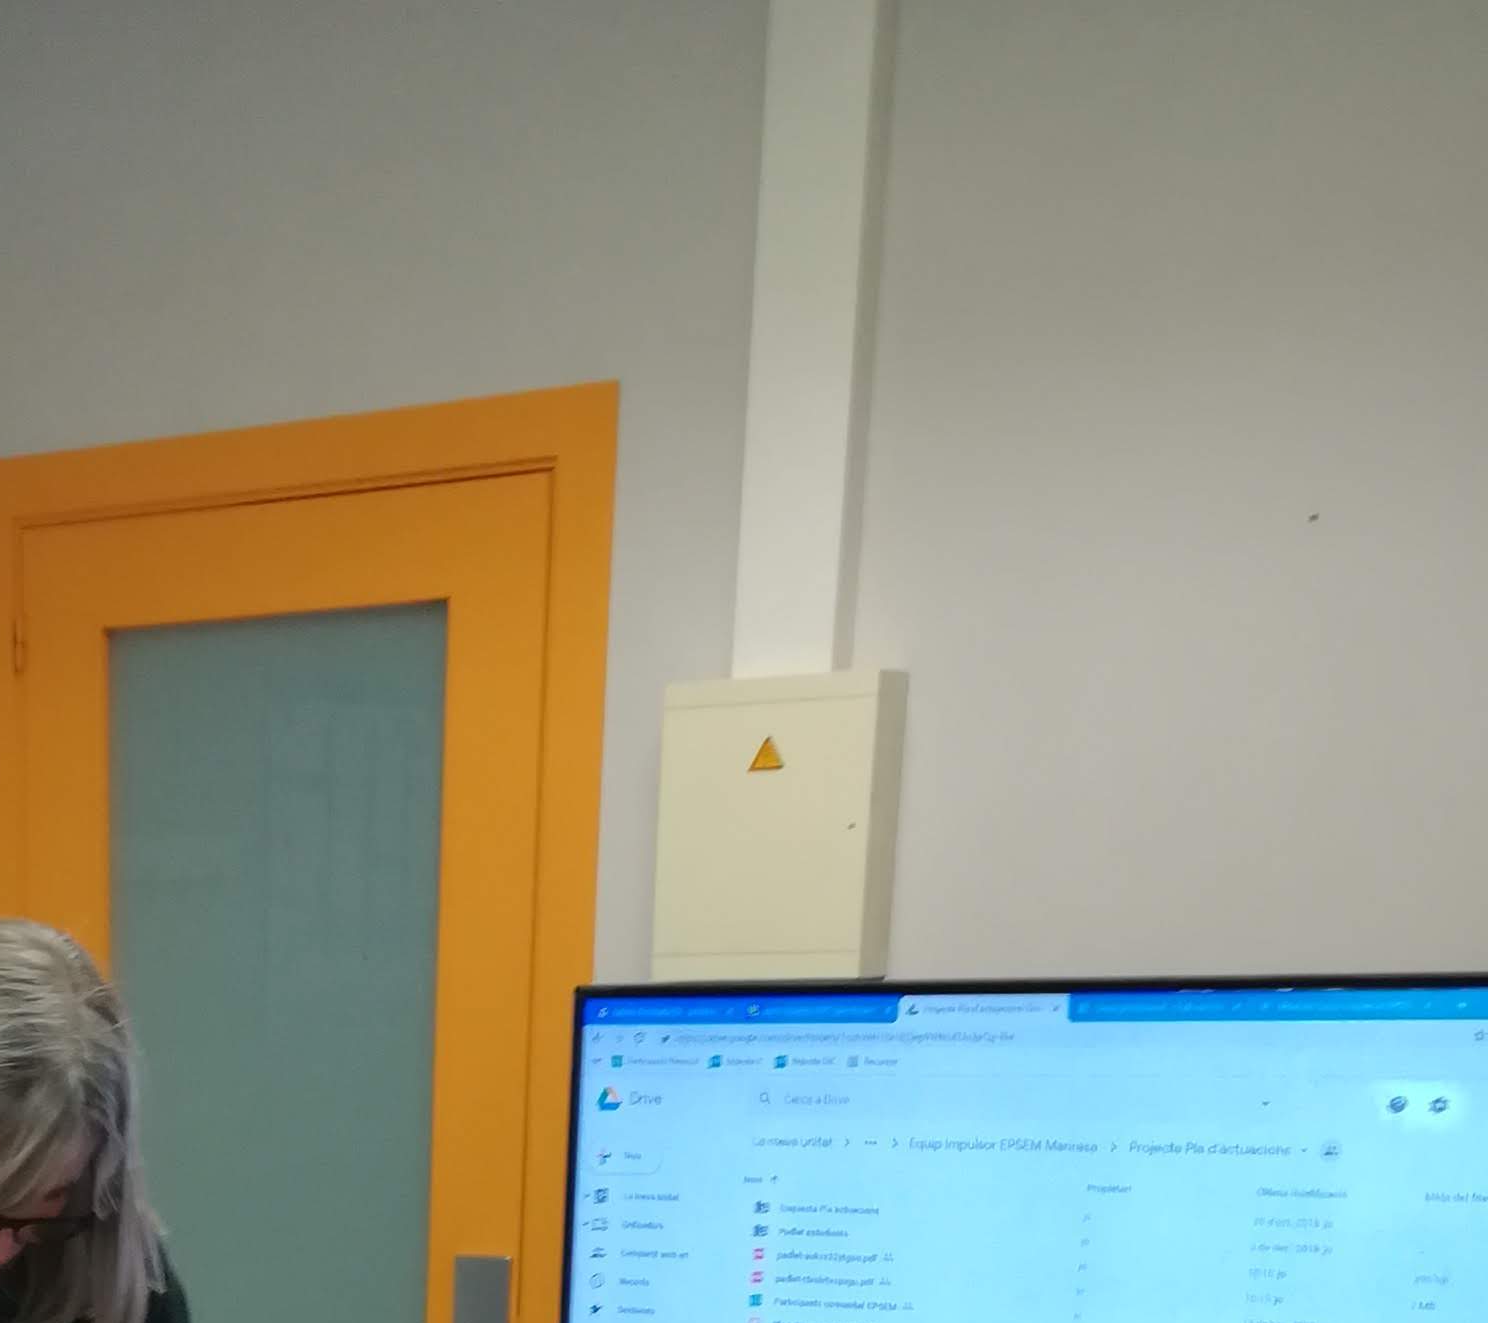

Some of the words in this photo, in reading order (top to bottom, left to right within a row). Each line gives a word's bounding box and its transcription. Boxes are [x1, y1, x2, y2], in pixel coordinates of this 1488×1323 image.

[629, 1092, 662, 1106] Drive
[909, 1137, 942, 1152] Equip
[945, 1136, 996, 1152] Impulsor
[999, 1138, 1042, 1151] EPSEM
